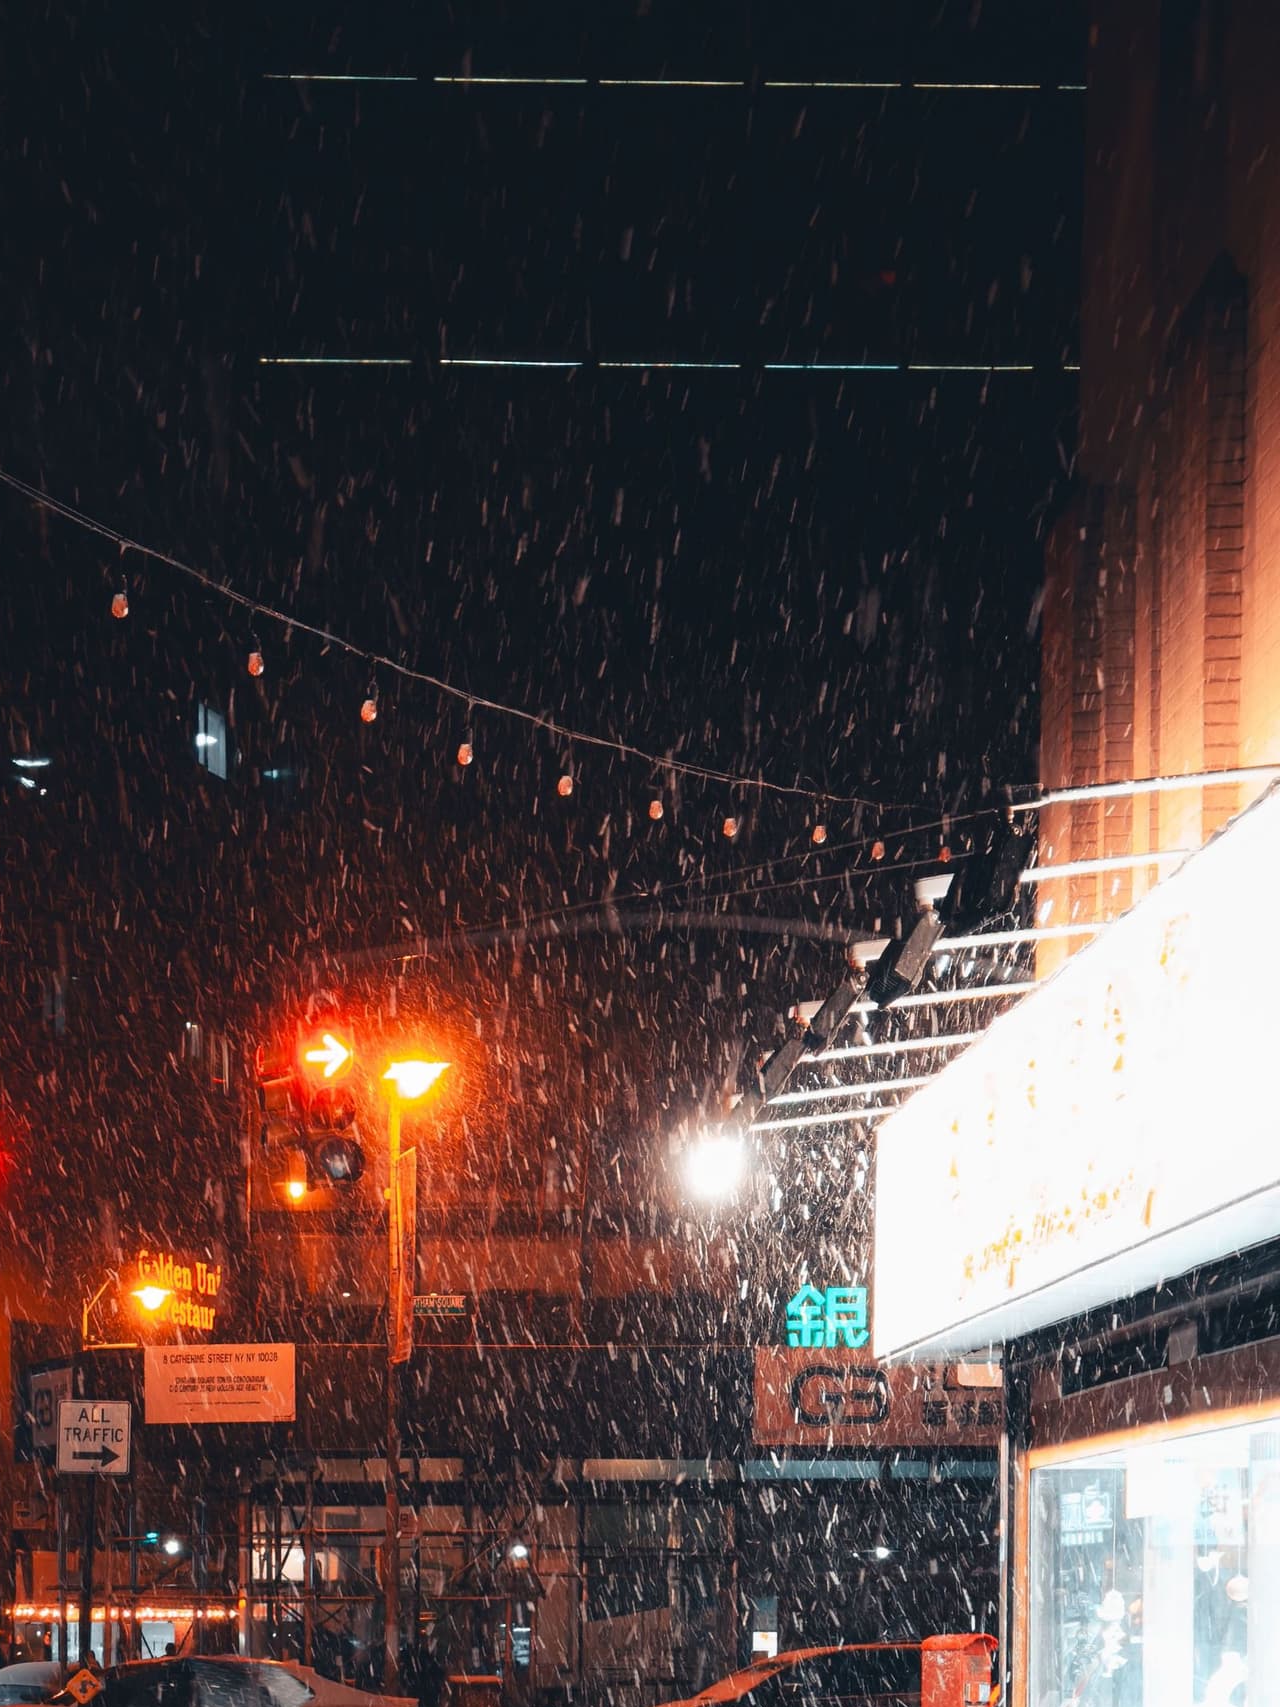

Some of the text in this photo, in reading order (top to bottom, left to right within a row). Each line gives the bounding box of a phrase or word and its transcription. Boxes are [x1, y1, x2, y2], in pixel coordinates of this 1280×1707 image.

[160, 1297, 216, 1330] estaur
[786, 1284, 869, 1348] 銀
[170, 1353, 205, 1364] CATHERINE
[208, 1352, 233, 1363] STREET
[235, 1352, 244, 1362] NY
[247, 1352, 256, 1362] NY
[78, 1407, 111, 1423] ALL
[64, 1427, 124, 1443] TRAFFIC
